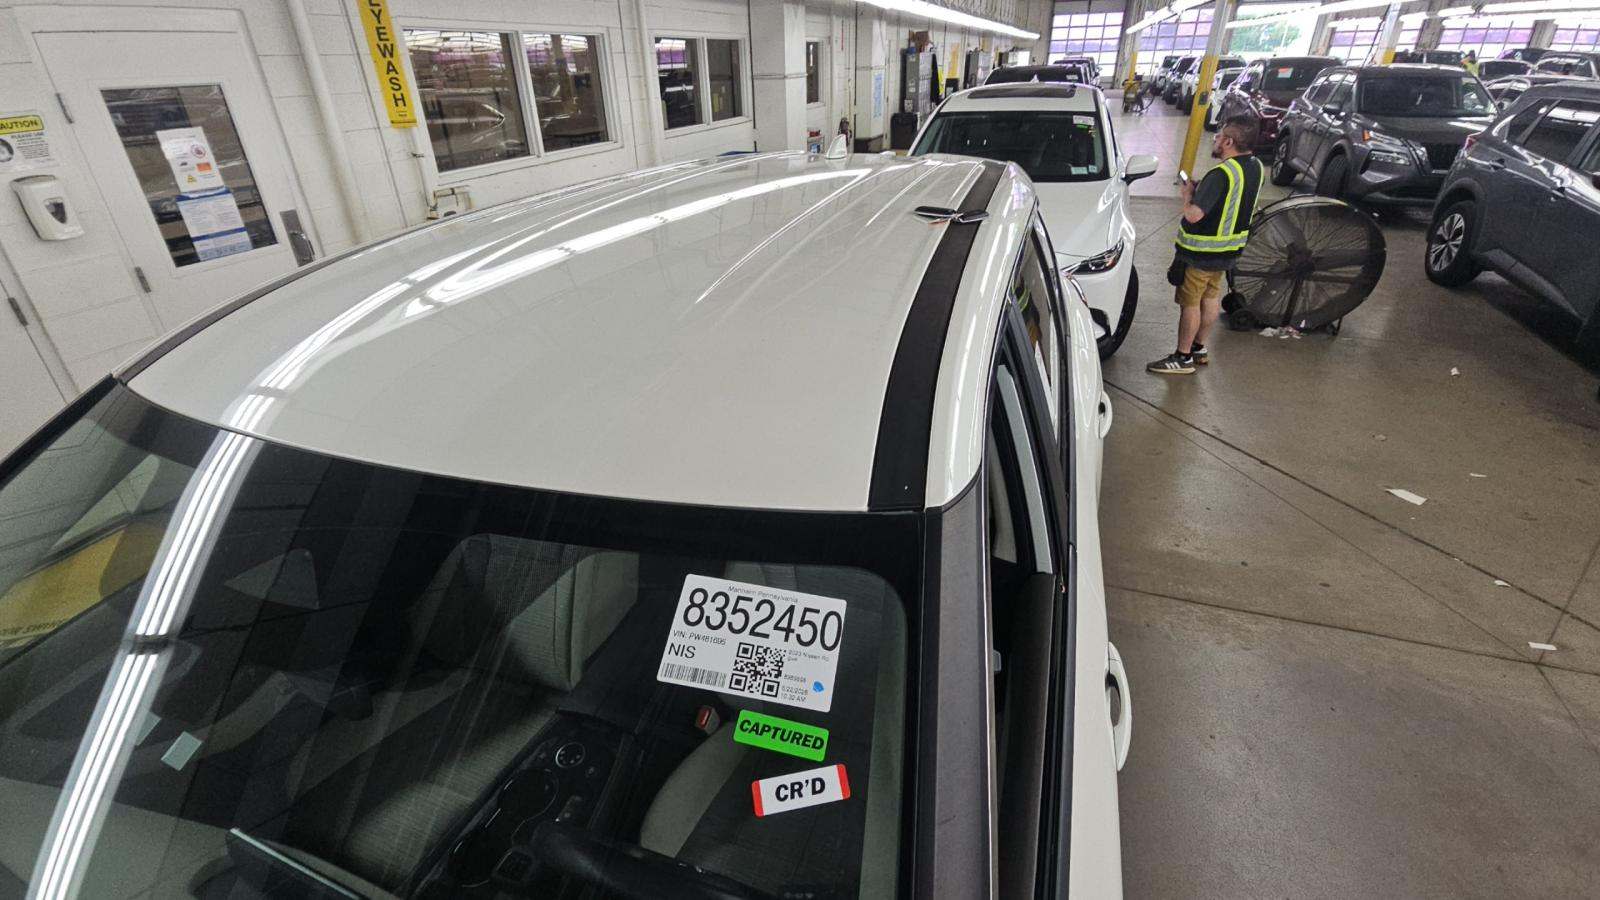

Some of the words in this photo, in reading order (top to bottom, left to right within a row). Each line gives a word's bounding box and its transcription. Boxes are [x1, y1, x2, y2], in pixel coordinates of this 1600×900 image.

[0, 119, 38, 130] AUTION
[683, 587, 842, 651] 8352450
[673, 629, 687, 638] VIN:
[668, 642, 696, 659] NIS
[739, 719, 825, 751] CAPTURED
[775, 776, 826, 802] CR'D
